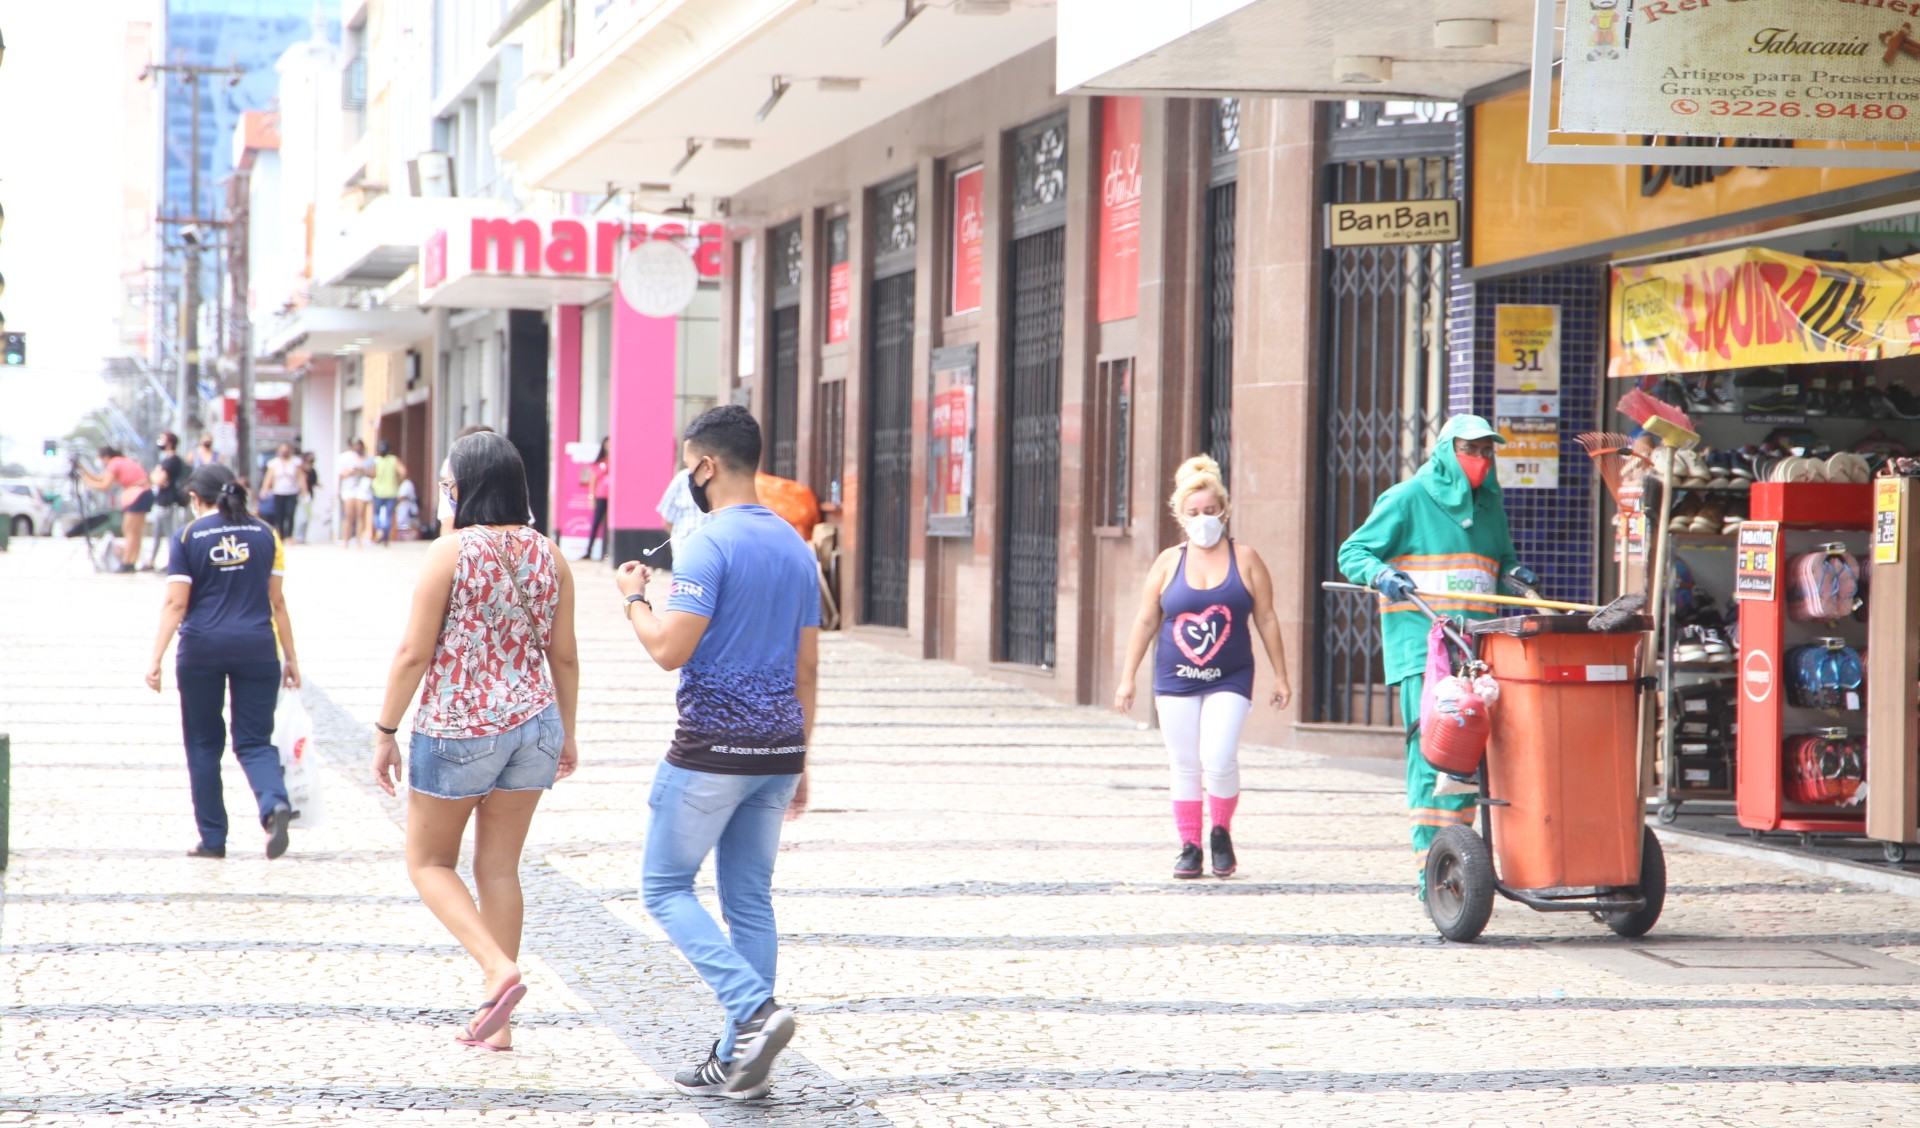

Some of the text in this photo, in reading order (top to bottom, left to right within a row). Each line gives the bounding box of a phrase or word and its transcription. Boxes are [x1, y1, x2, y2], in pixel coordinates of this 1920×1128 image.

[1748, 27, 1869, 57] Tabacaria
[1660, 66, 1920, 85] Artigos para Presentes
[1660, 82, 1920, 100] Gravações e Consertos
[1710, 100, 1908, 120] 3226.9480
[1338, 207, 1450, 231] BanBan
[469, 218, 723, 277] mara
[1513, 349, 1543, 372] 31
[1175, 664, 1222, 681] ZUMBA
